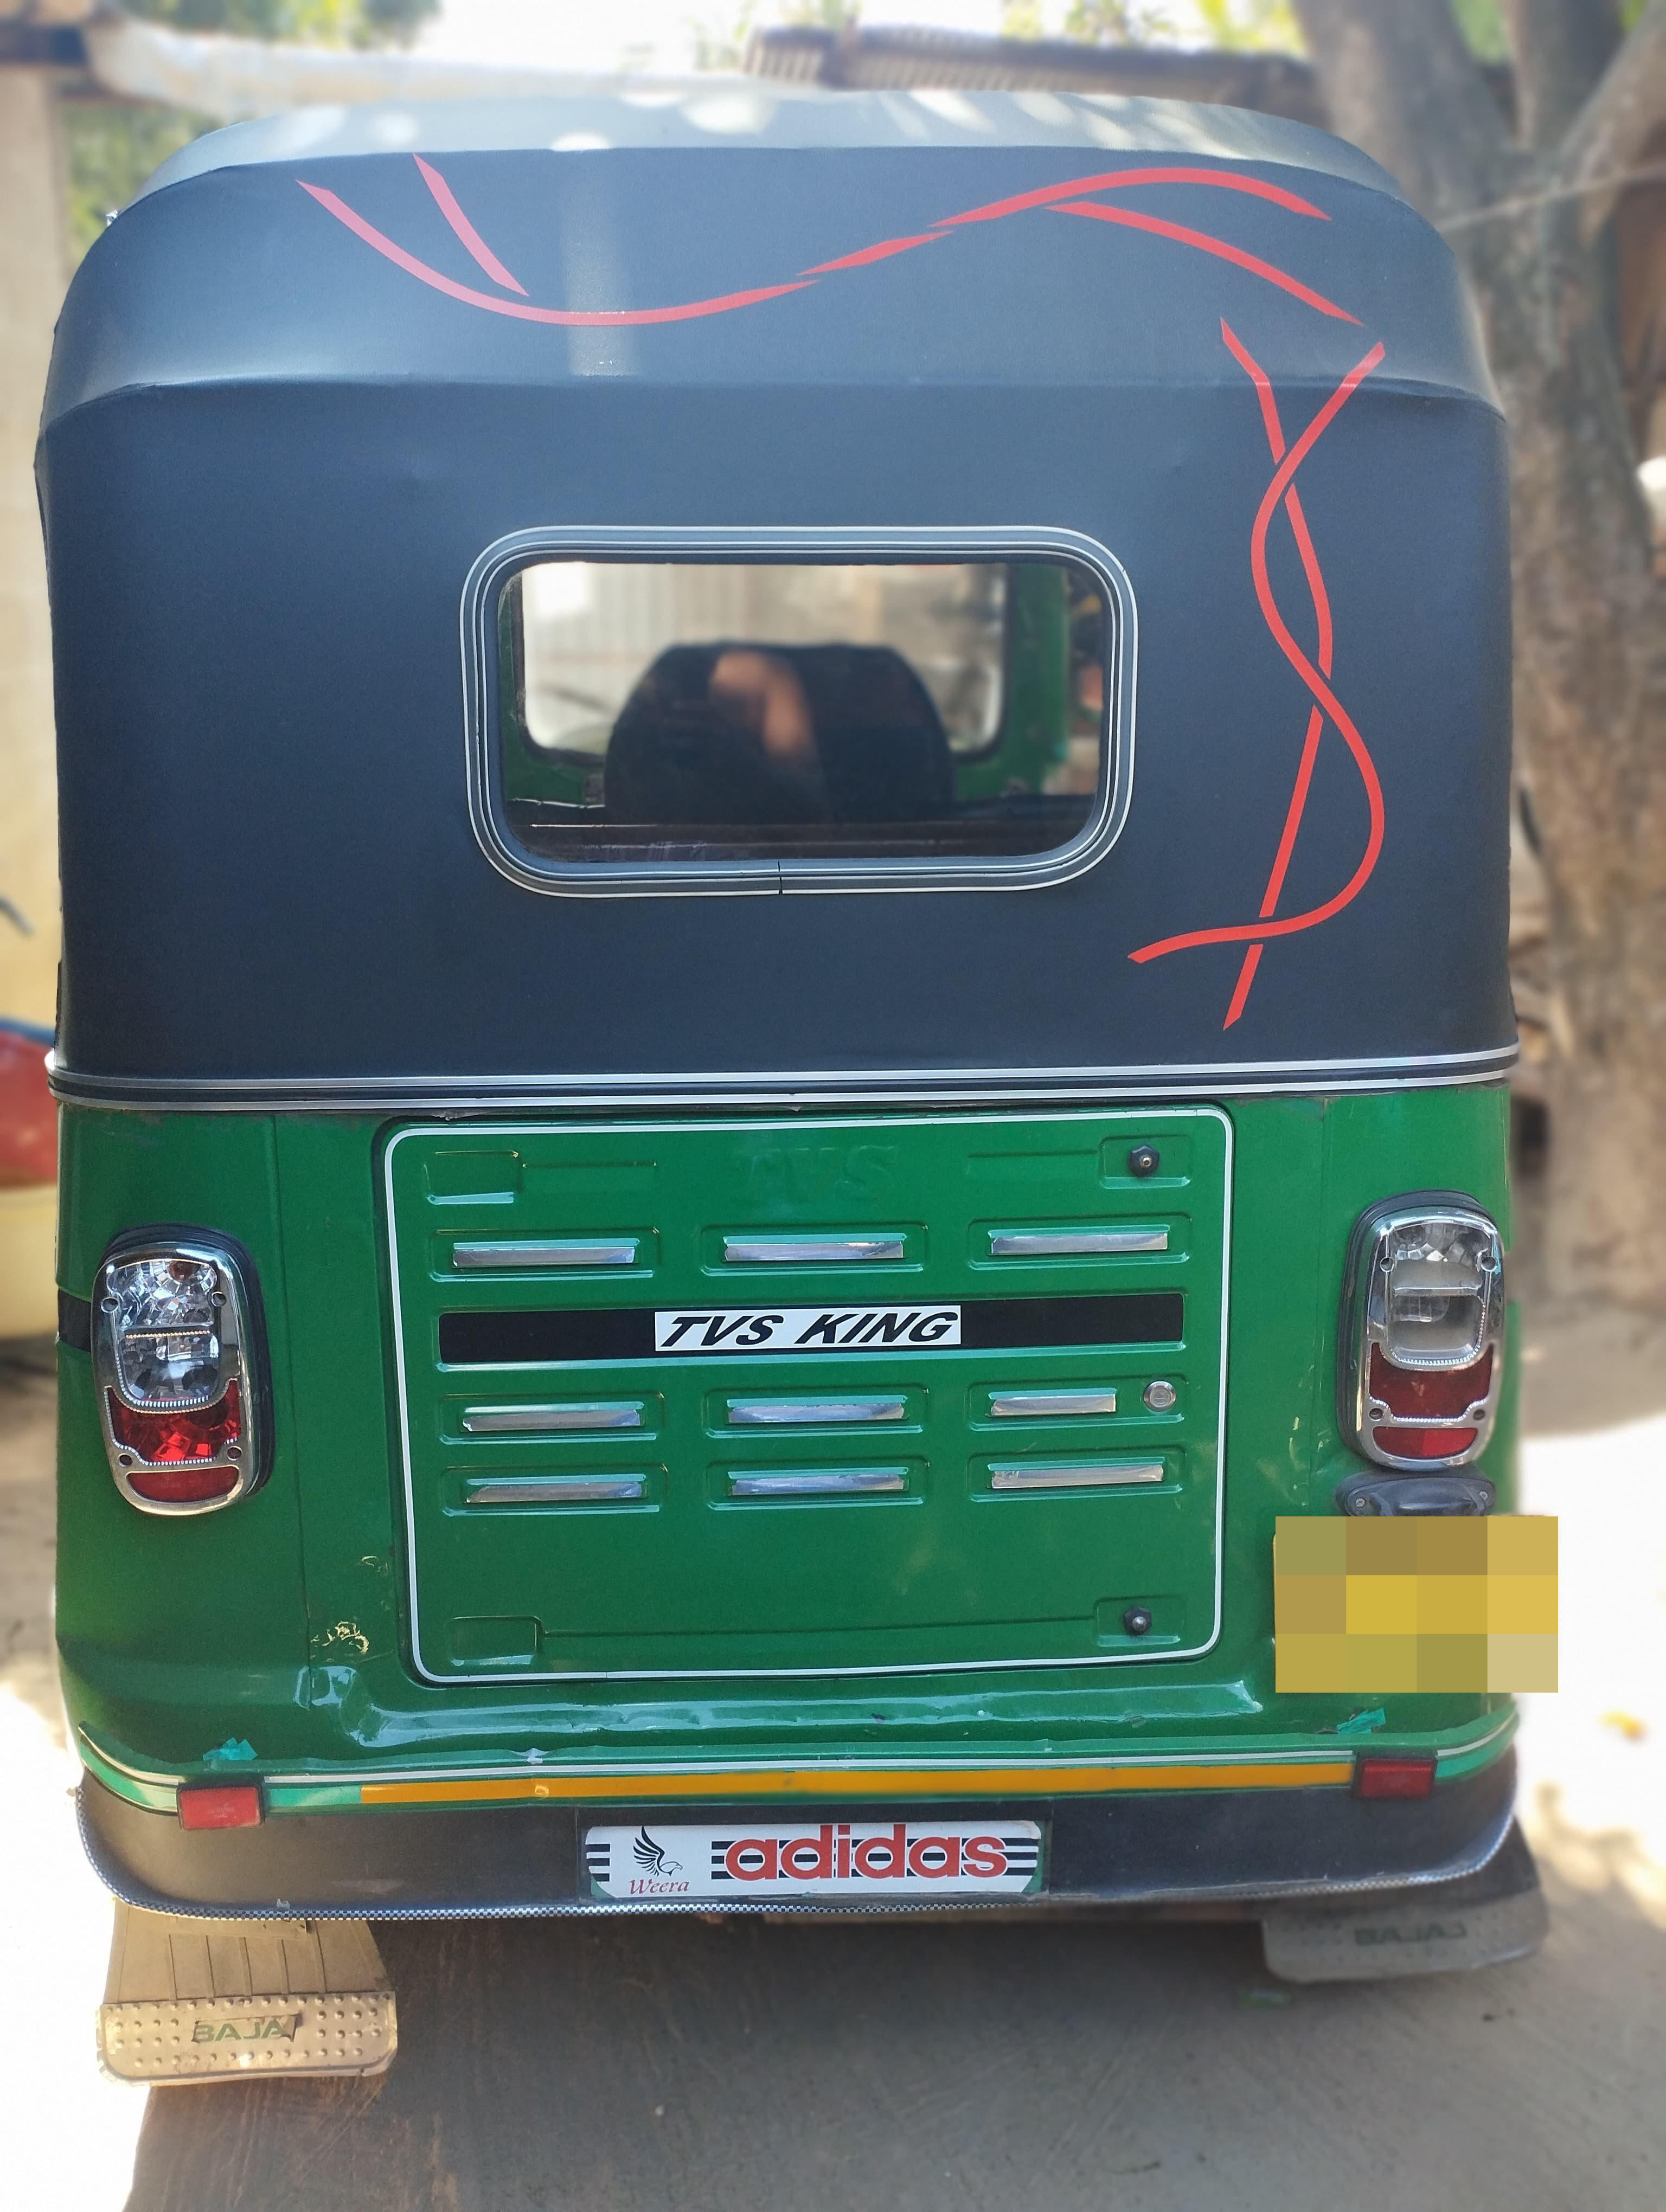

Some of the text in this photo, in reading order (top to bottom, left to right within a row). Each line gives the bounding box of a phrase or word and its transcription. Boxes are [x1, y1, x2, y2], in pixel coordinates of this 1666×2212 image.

[660, 1312, 958, 1347] TVS KING
[726, 1824, 1007, 1880] adidas
[629, 1879, 689, 1894] Weera
